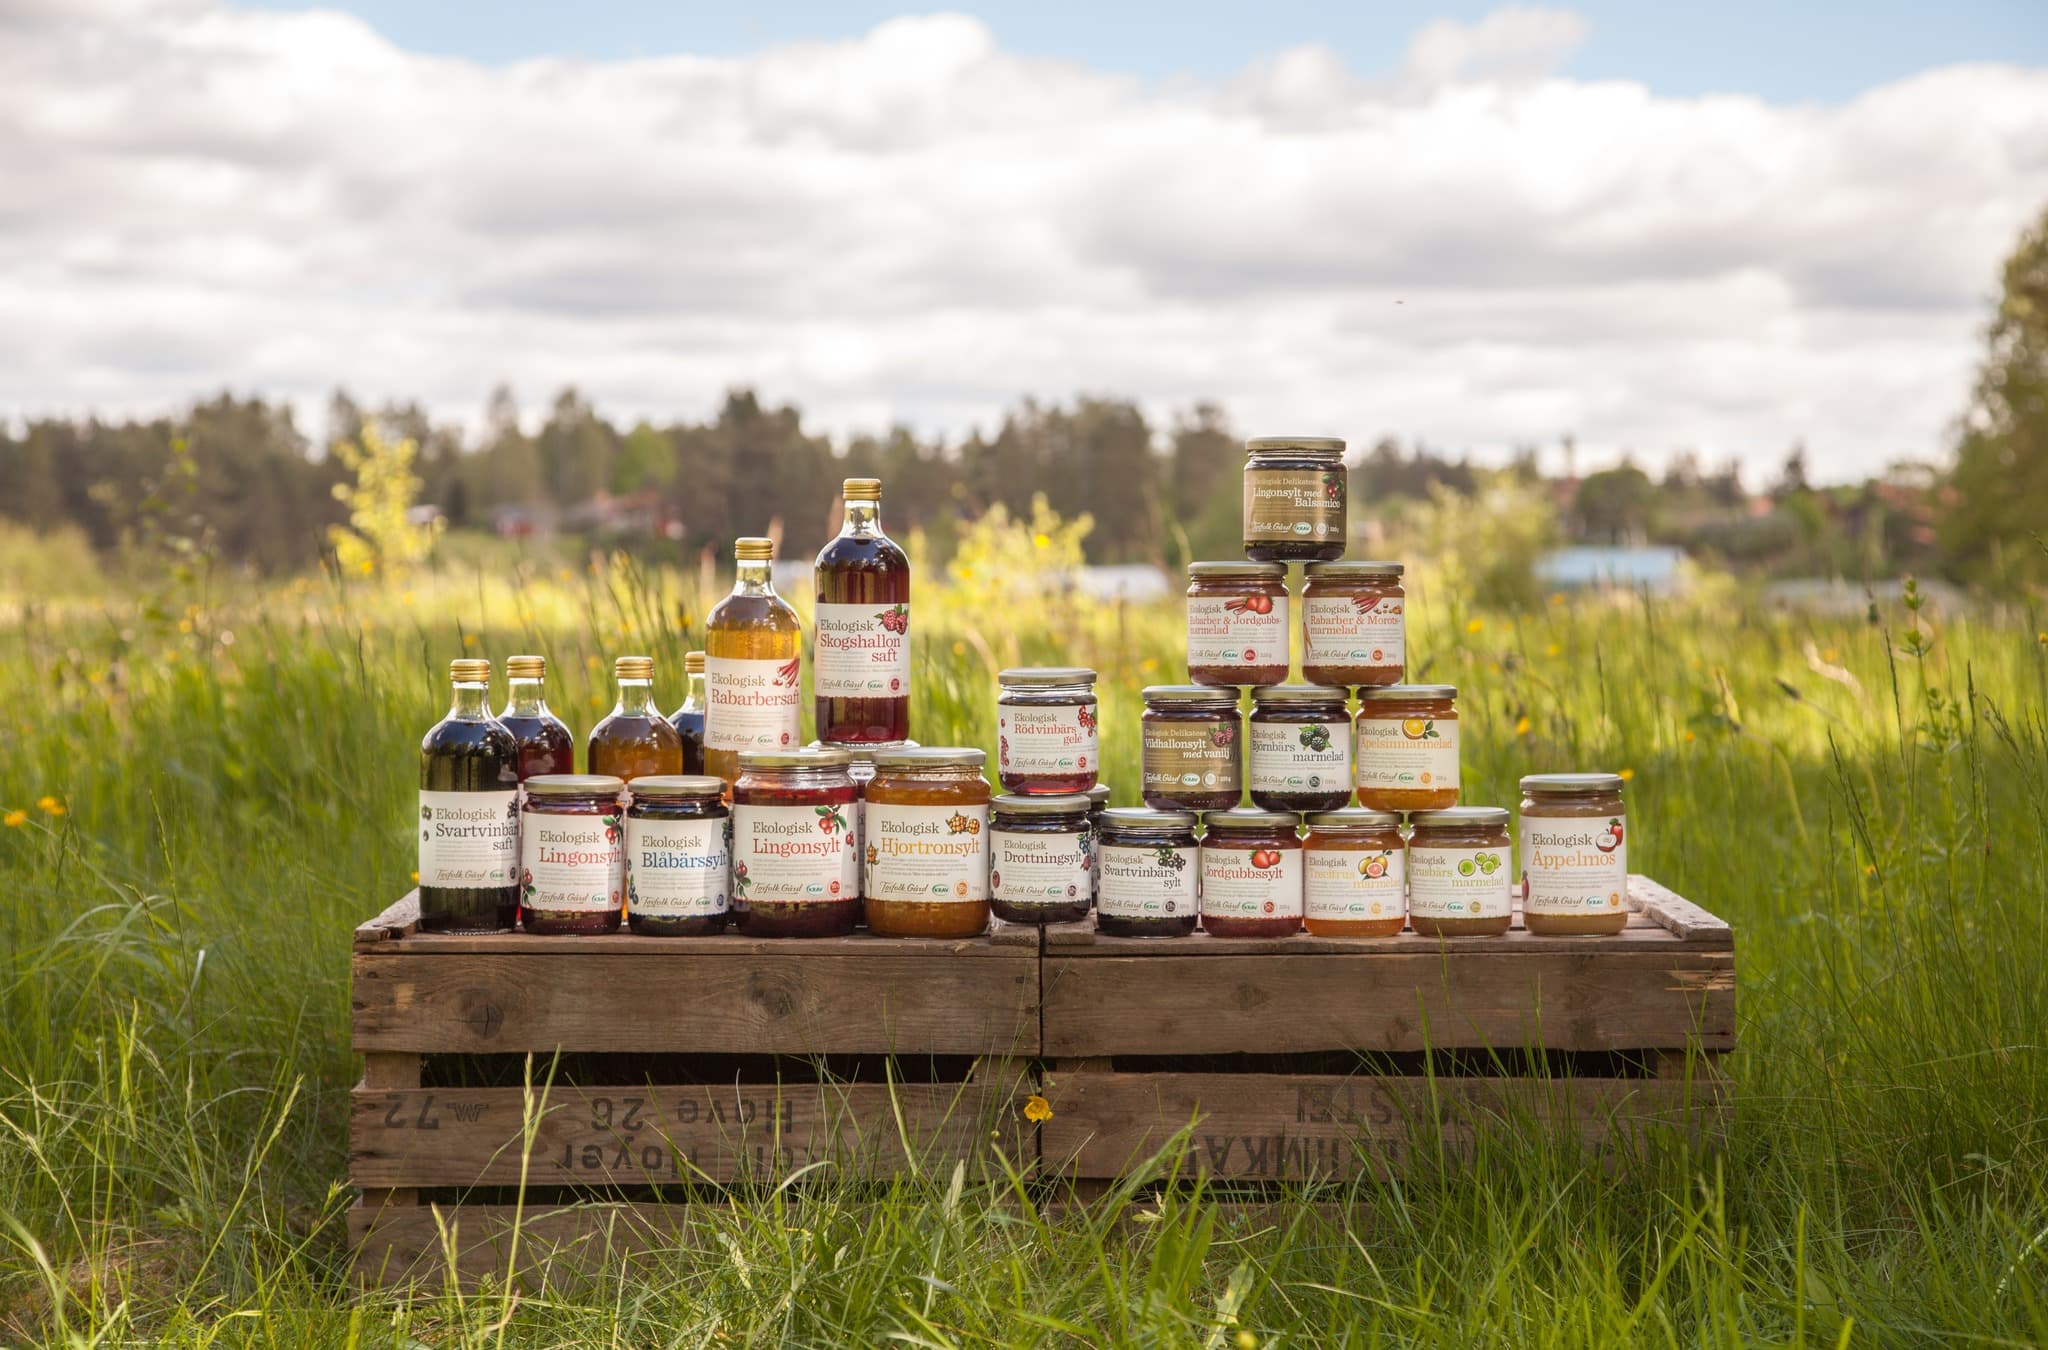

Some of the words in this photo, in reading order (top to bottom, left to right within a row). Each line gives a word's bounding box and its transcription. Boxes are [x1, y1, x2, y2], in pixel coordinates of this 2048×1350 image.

[1253, 488, 1301, 498] Lingonsylt
[1304, 489, 1322, 497] med
[1294, 497, 1341, 508] Balsamico
[1310, 605, 1350, 615] Ekologisk
[820, 619, 874, 634] Ekologisk
[1224, 616, 1231, 625] &
[1233, 615, 1282, 626] Jordgubbs-
[1310, 616, 1354, 625] Rabarber
[1356, 616, 1364, 625] &
[1310, 625, 1358, 634] marmelad
[820, 634, 901, 650] Skogshallon
[872, 648, 898, 662] saft
[712, 672, 766, 688] Ekologisk
[712, 688, 800, 706] Rabarbersaft
[1014, 712, 1057, 724] Ekologisk
[1014, 724, 1035, 734] Röd
[1036, 724, 1078, 734] vinbärs
[1252, 730, 1286, 740] Ekologisk
[1360, 726, 1399, 737] Ekologisk
[1063, 735, 1083, 746] gelé
[1252, 740, 1296, 753] Björnbärs
[1183, 750, 1202, 758] med
[1204, 748, 1230, 760] vanilj
[1292, 751, 1344, 762] marmelad
[436, 808, 496, 822] Ekologisk
[752, 822, 814, 836] Ekologisk
[880, 820, 940, 836] Ekologisk
[492, 837, 513, 850] saft
[540, 831, 600, 845] Ekologisk
[642, 835, 702, 850] Ekologisk
[1532, 833, 1592, 848] Ekologisk
[752, 838, 841, 858] Lingonsylt
[881, 838, 980, 856] Hjortronsylt
[1004, 840, 1047, 852] Ekologisk
[539, 846, 620, 866] Lingonsylt
[642, 850, 727, 872] Blåbärssylt
[1004, 850, 1082, 866] Drottningsylt
[1104, 853, 1144, 866] Ekologisk
[1204, 854, 1241, 866] Ekologisk
[1309, 856, 1348, 868] Ekologisk
[1532, 846, 1616, 870] Äppelmos
[1104, 864, 1175, 878] Svartvinbärs
[1204, 866, 1284, 882] Jordgubbssylt
[1164, 876, 1182, 890] sylt
[1452, 876, 1504, 888] marmelad
[384, 1094, 440, 1130] 72
[590, 1098, 645, 1132] 26
